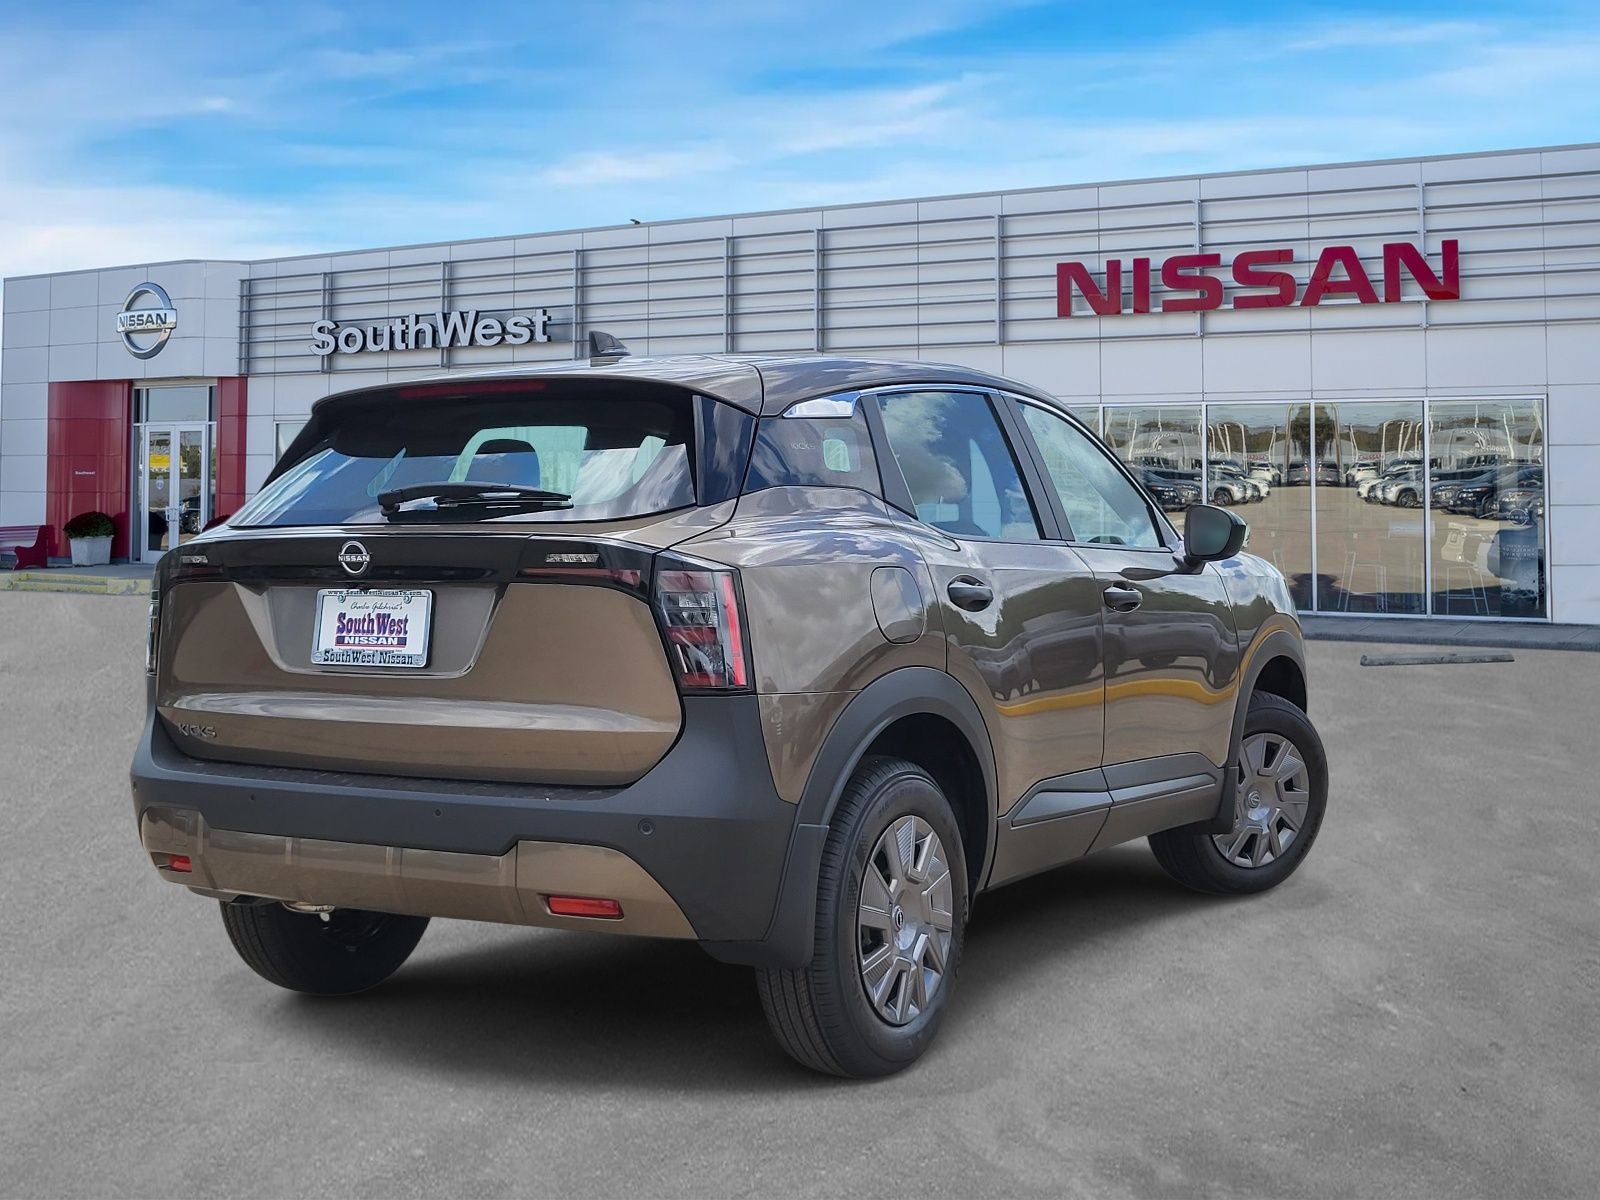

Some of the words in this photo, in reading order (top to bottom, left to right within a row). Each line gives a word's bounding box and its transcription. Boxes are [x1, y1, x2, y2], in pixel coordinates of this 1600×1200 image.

[1056, 239, 1461, 318] NISSAN
[118, 312, 168, 328] NISSAN
[310, 308, 551, 356] SouthWest
[338, 554, 370, 562] NISSAN
[344, 635, 399, 645] NISSAN
[378, 651, 413, 664] Nissan
